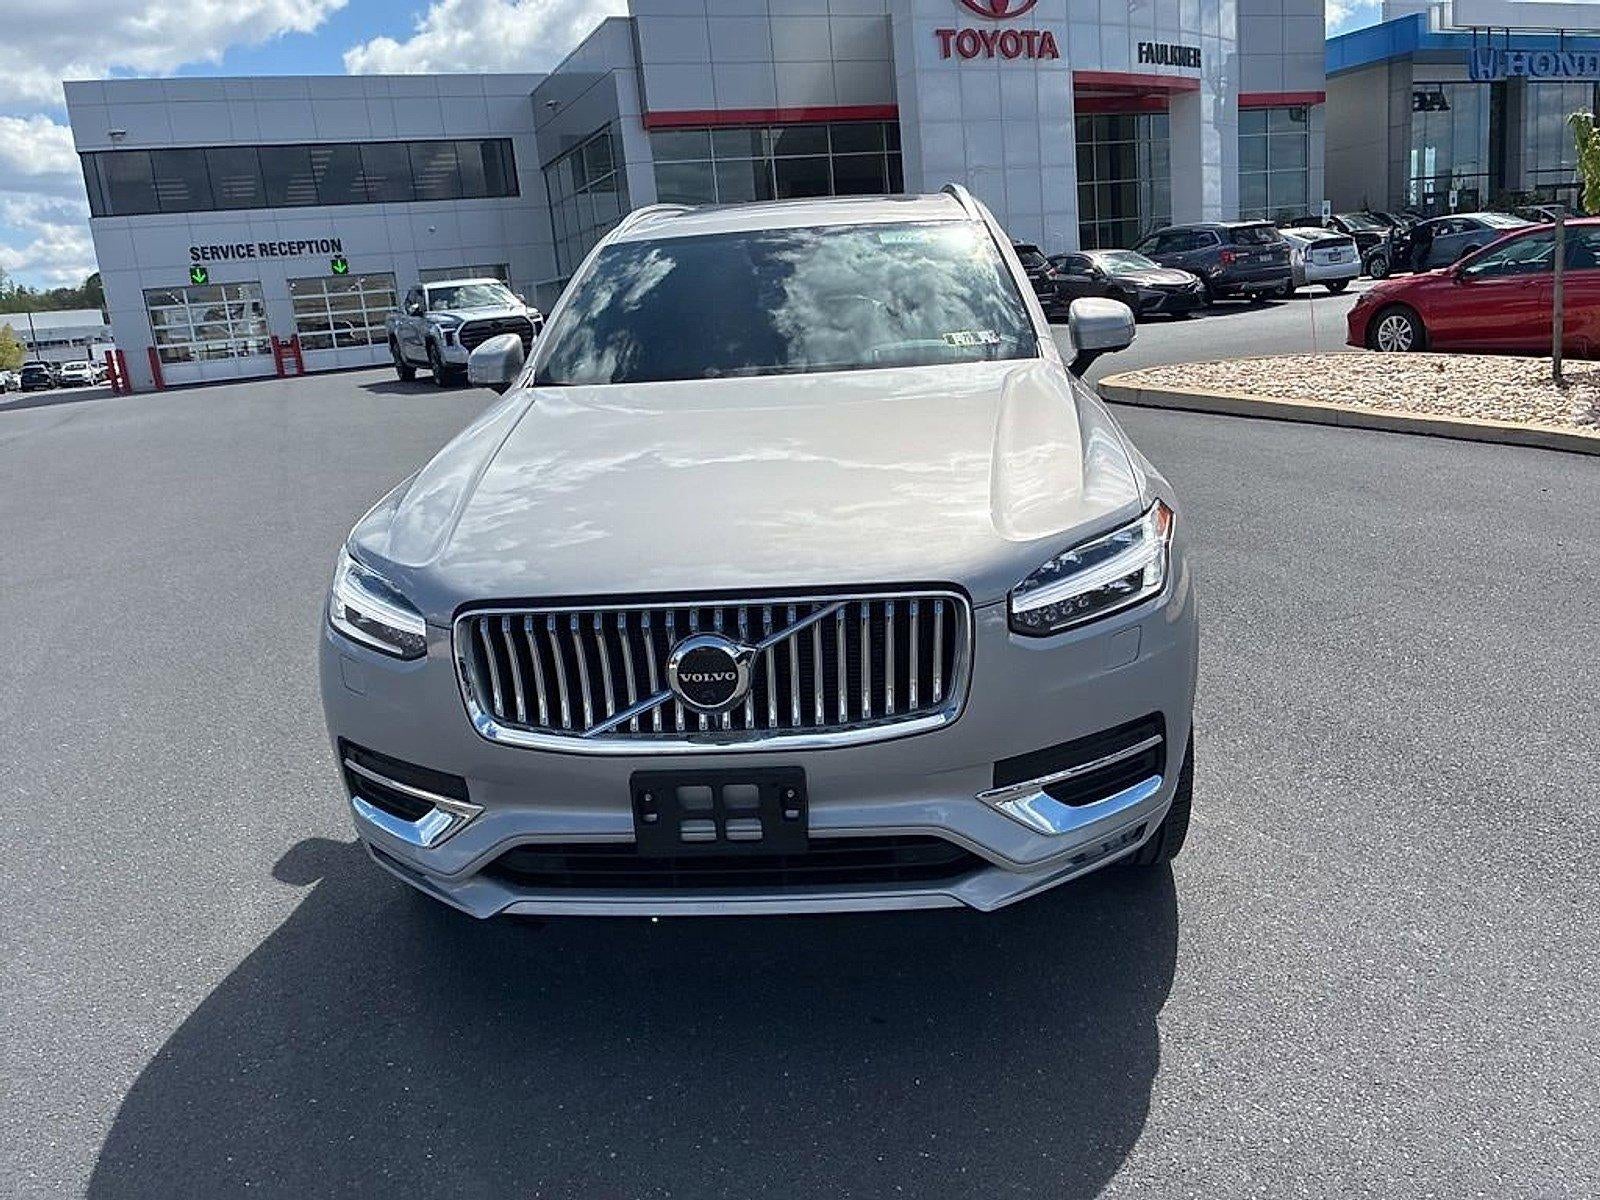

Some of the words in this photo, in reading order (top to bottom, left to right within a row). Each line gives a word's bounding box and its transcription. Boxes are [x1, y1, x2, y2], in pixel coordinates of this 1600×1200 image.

[936, 28, 1059, 59] TOYOTA
[1138, 42, 1201, 68] FAULKNER
[189, 243, 256, 261] SERVICE
[258, 238, 342, 257] RECEPTION
[679, 672, 736, 682] VOLVO
